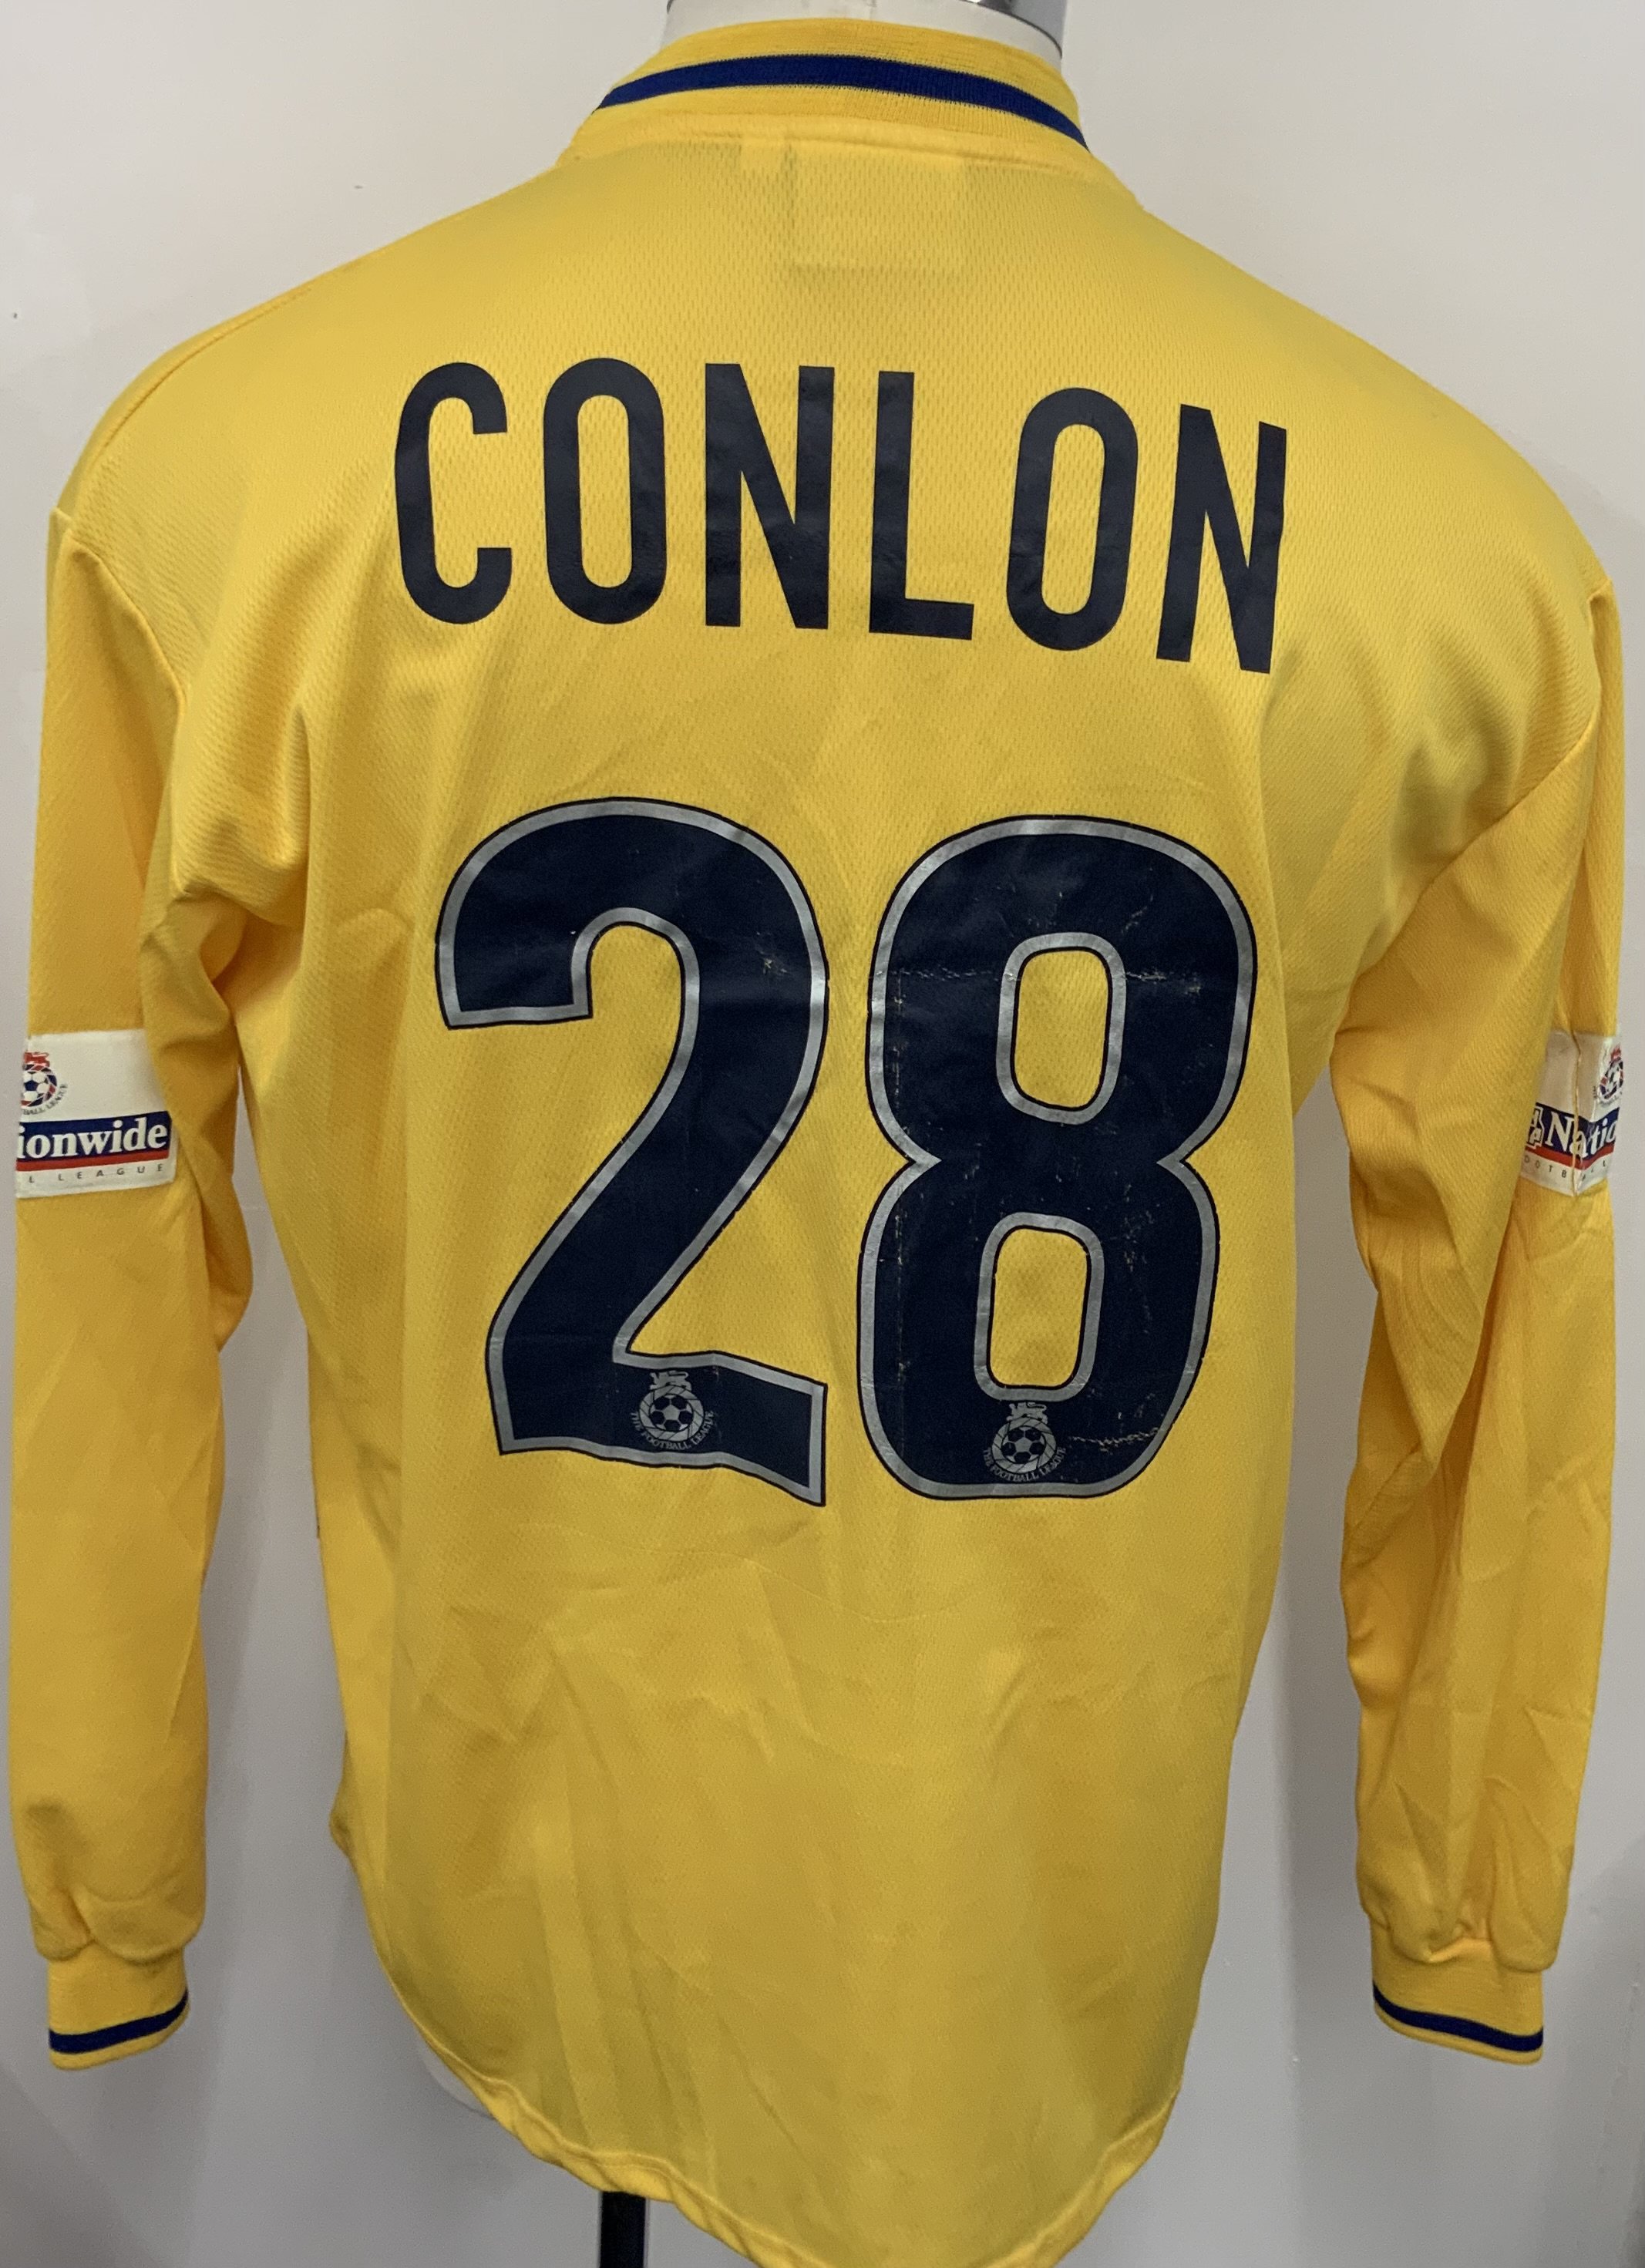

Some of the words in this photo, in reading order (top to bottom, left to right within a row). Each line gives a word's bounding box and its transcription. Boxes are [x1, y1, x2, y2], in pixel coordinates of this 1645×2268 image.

[395, 357, 1287, 674] CONLON
[17, 1117, 168, 1159] ionwide
[58, 1163, 163, 1181] LEAGUE
[435, 796, 1257, 1506] 28
